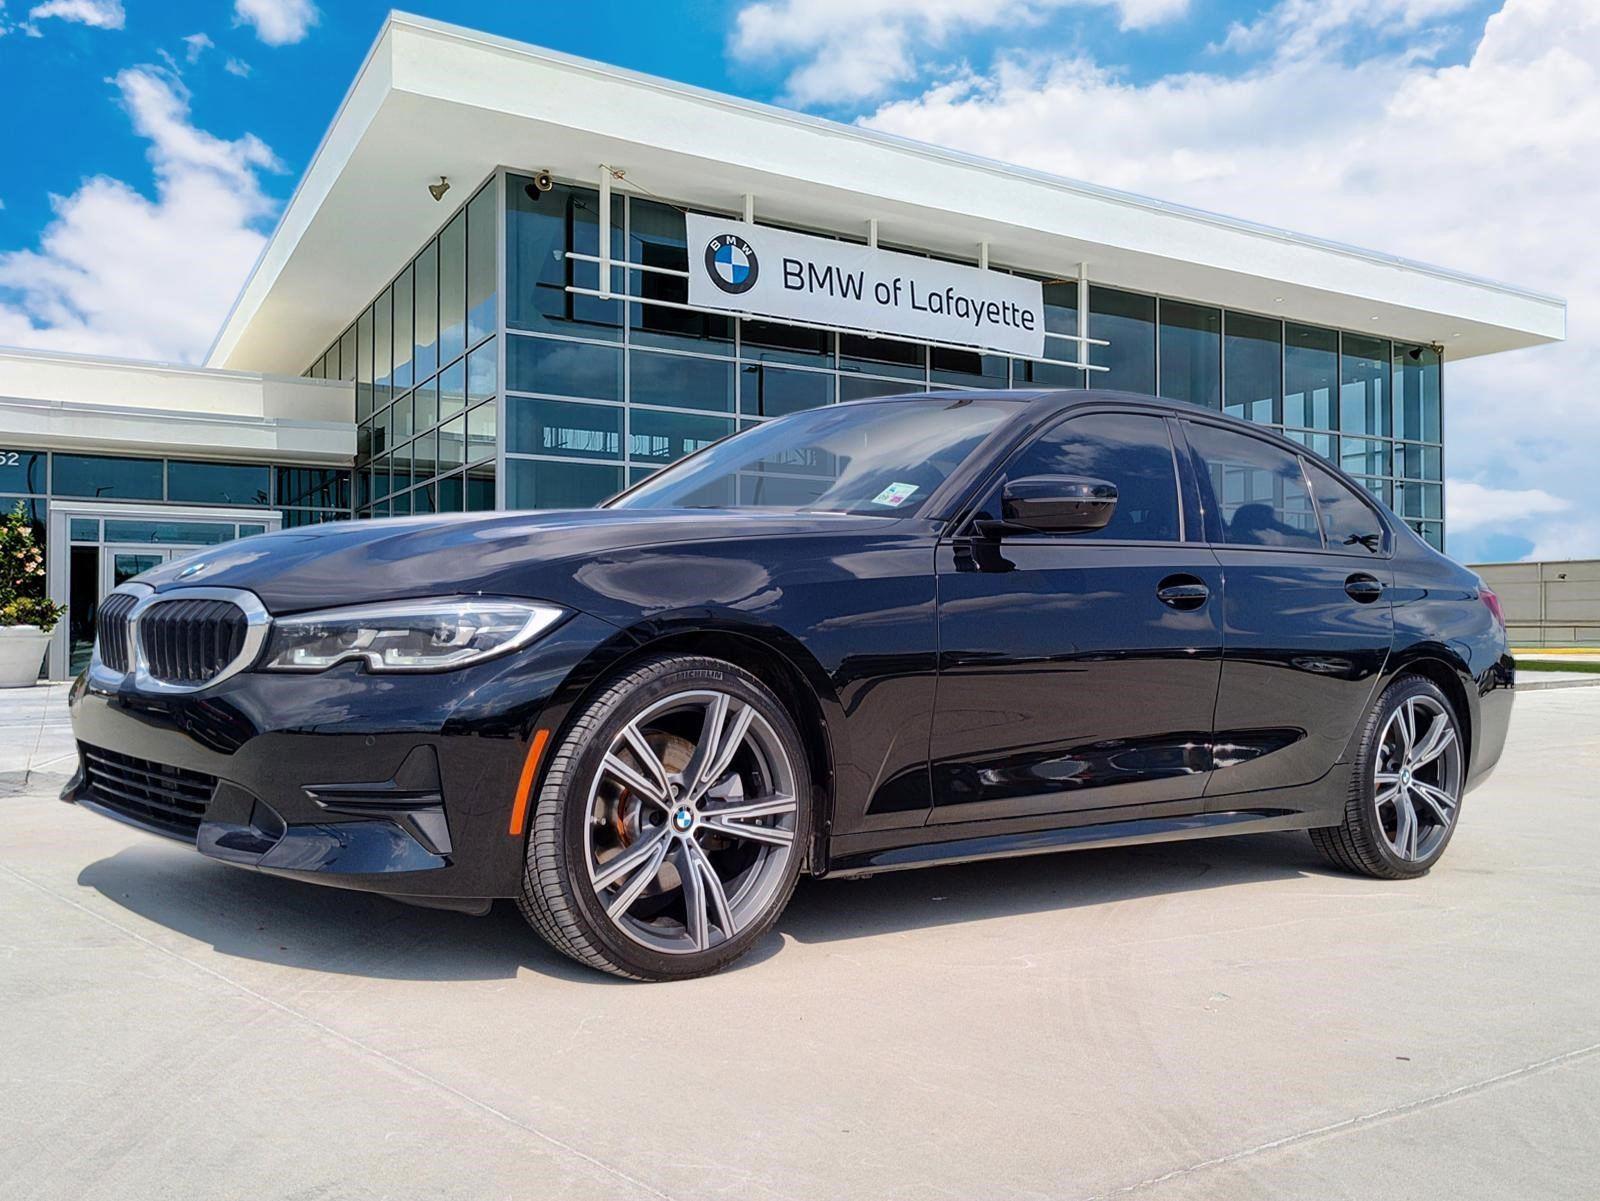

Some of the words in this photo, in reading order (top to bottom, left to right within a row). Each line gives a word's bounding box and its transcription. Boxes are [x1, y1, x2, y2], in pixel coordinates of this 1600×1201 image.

[710, 235, 752, 255] BMW
[783, 258, 864, 300] BMW
[874, 278, 901, 306] of
[911, 280, 1035, 331] Lafayette
